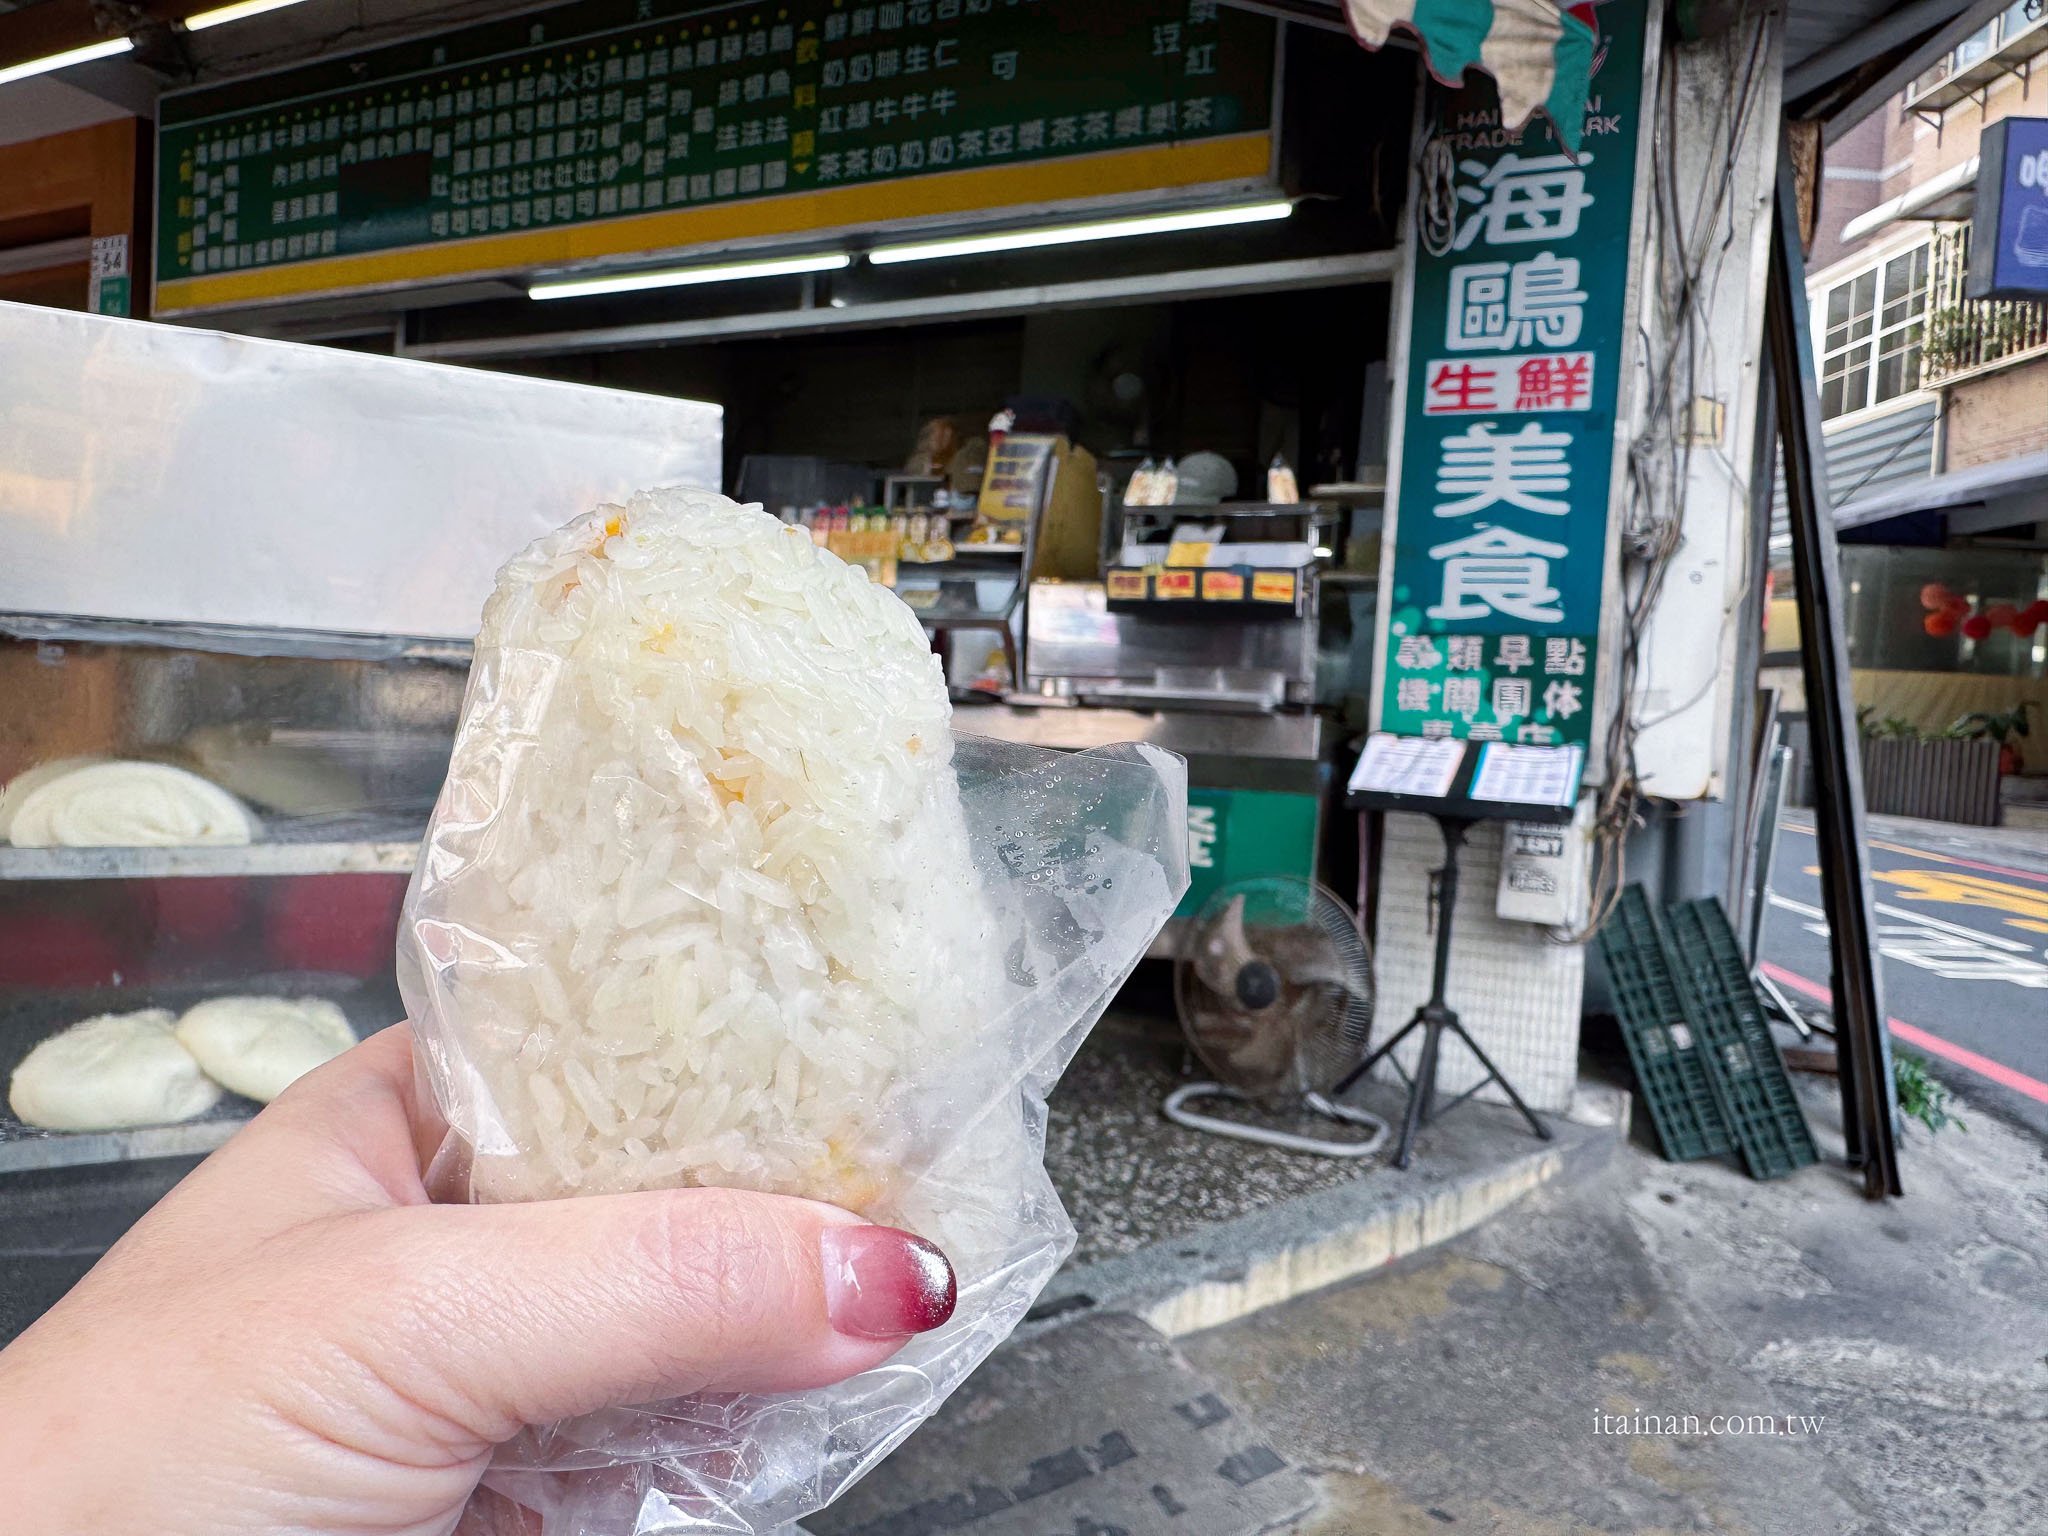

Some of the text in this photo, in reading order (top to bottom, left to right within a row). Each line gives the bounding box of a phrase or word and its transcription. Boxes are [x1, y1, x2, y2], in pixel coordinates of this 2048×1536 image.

[1444, 151, 1595, 351] 海鷗
[1428, 355, 1590, 413] 生鮮
[1425, 421, 1574, 624] 美食
